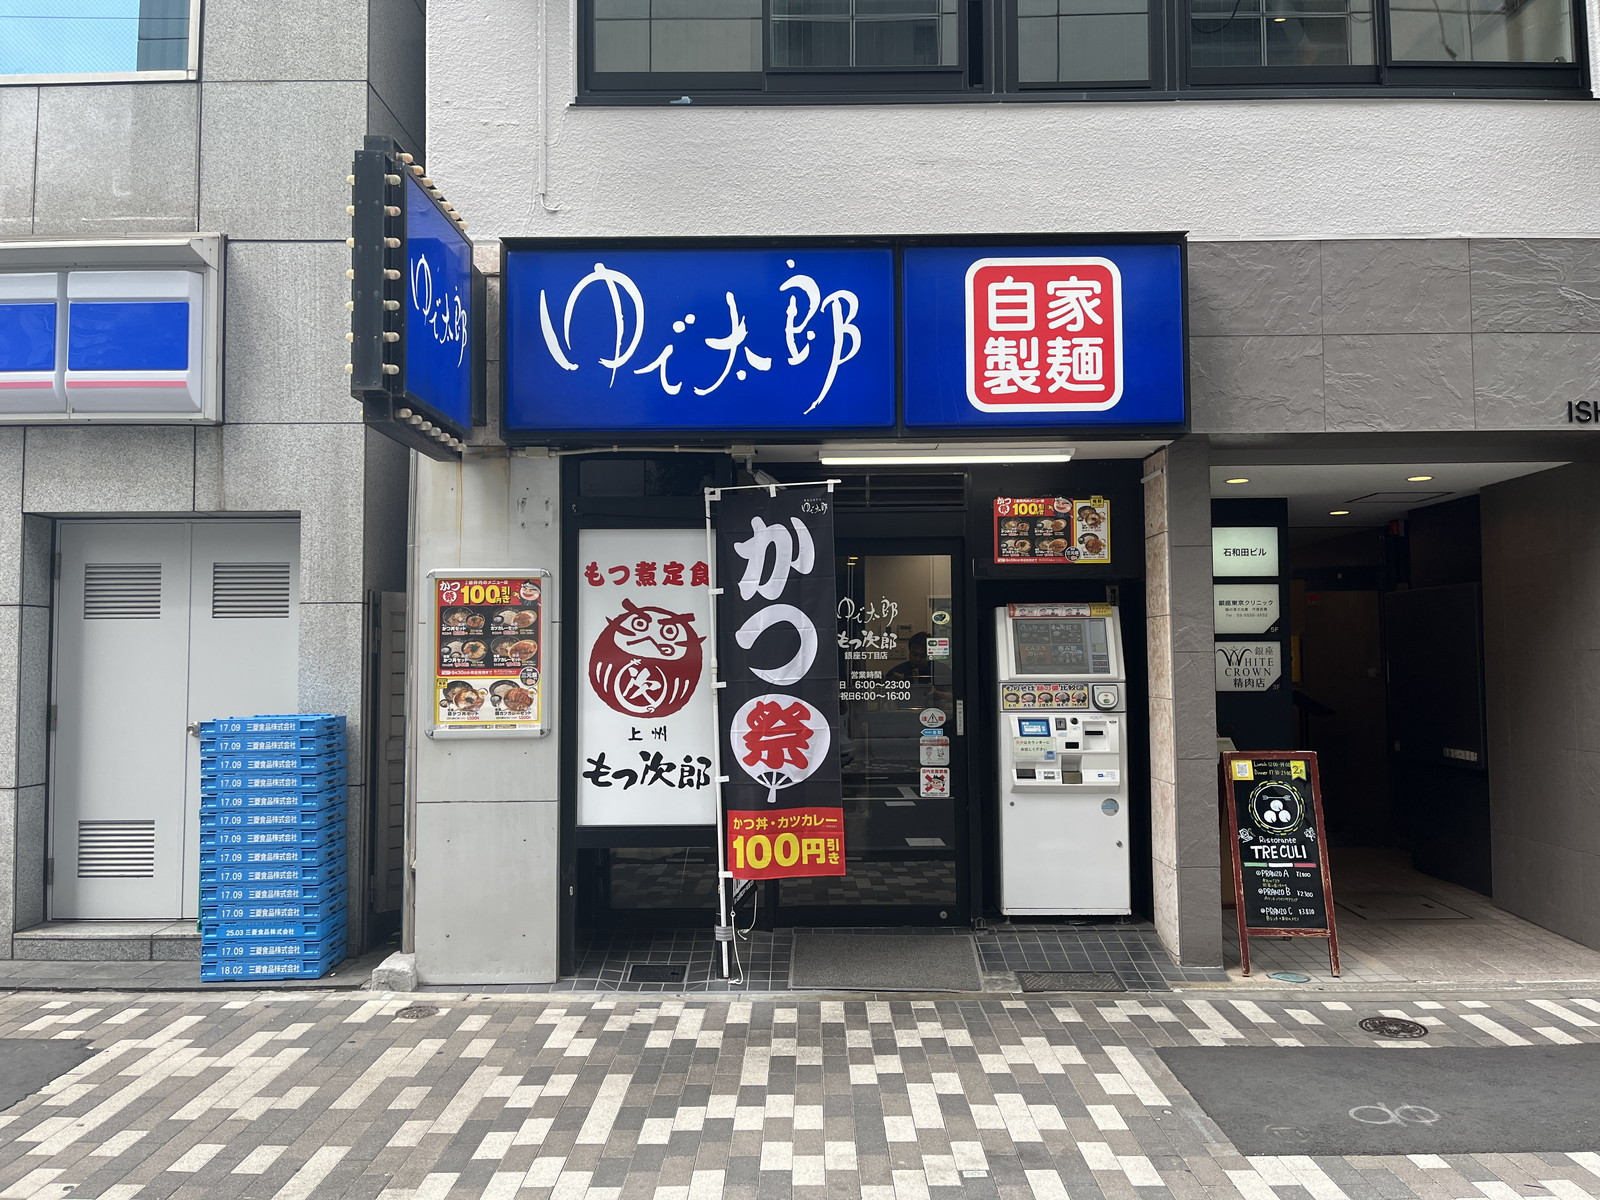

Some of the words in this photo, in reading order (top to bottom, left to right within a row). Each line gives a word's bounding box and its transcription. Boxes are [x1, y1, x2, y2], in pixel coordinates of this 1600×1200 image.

[410, 253, 467, 368] ゆで太郎
[539, 259, 862, 414] ゆで太郎
[1223, 548, 1267, 557] 石和田ビル
[584, 560, 709, 586] もつ煮定食
[837, 630, 898, 650] もつ次郎
[1255, 646, 1274, 655] 銀座
[844, 651, 888, 660] 銀座5丁目店
[850, 671, 882, 679] 営業時間
[1224, 667, 1271, 677] CROWN
[1233, 677, 1265, 688] 精肉店
[219, 723, 241, 732] 17.09
[246, 722, 296, 732] 三菱食品株式会社
[219, 742, 241, 750] 17.09
[246, 741, 296, 750] 三菱食品株式会社
[220, 761, 242, 769] 17.09
[247, 760, 297, 769] 三菱食品株式会社
[582, 750, 712, 790] もつ次郎
[220, 779, 242, 787] 17.09
[247, 778, 297, 787] 三菱食品株式会社
[220, 798, 242, 806] 17.09
[247, 797, 298, 806] 三菱食品株式会社
[219, 816, 241, 824] 17.09
[247, 815, 297, 824] 三菱食品株式会社
[733, 814, 838, 830] かつ丼・カツカレー
[219, 835, 241, 843] 17.09
[246, 834, 297, 843] 三菱食品株式会社
[1259, 835, 1297, 843] Ristorante
[220, 853, 242, 862] 17.09
[247, 852, 298, 862] 三菱食品株式会社
[220, 872, 242, 880] 17.09
[248, 871, 299, 880] 三菱食品株式会社
[221, 891, 243, 899] 17.09
[248, 890, 299, 899] 三菱食品株式会社
[221, 909, 243, 917] 17.09
[249, 908, 300, 917] 三菱食品株式会社
[245, 928, 294, 936] 三菱食品株式会社
[221, 947, 243, 955] 17.09
[249, 946, 300, 955] 三菱食品株式会社
[221, 966, 243, 975] 18.02
[248, 964, 300, 974] 三菱食品株式会社
